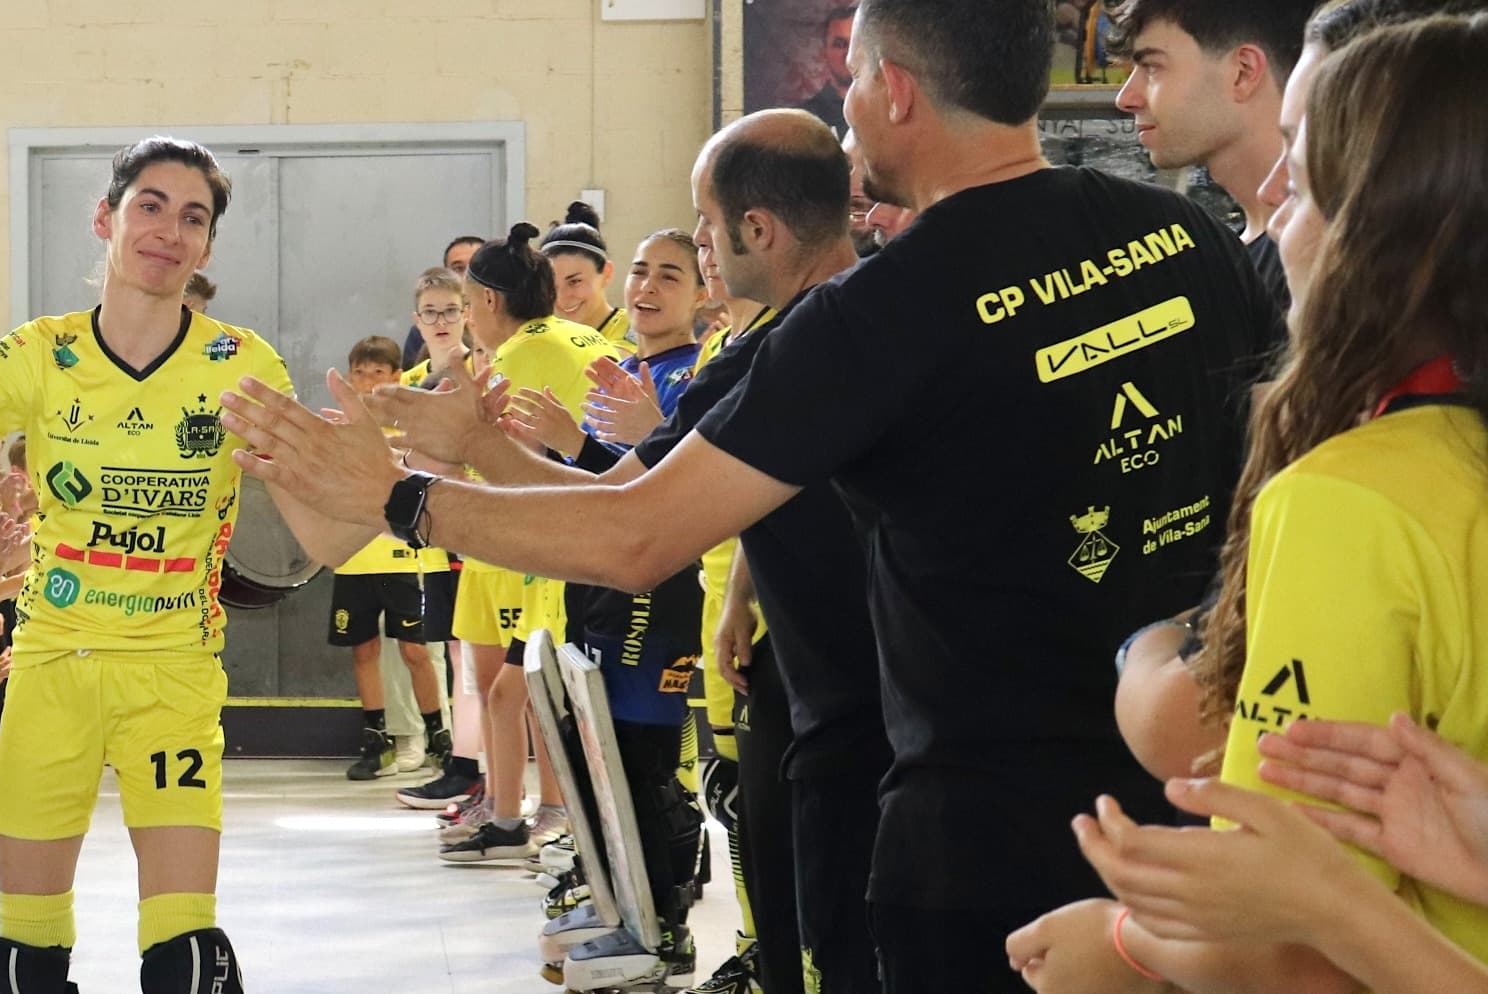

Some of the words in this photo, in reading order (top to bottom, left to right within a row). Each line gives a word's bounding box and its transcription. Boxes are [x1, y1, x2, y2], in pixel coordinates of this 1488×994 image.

[975, 285, 1025, 325] CP
[1029, 223, 1196, 305] VILA-SANA
[1047, 319, 1167, 373] VALL
[116, 421, 154, 430] ALTAN
[1094, 414, 1184, 465] ALTAN
[100, 474, 210, 488] COOPERATIVA
[1120, 450, 1160, 474] ECO
[101, 487, 208, 508] D'IVARS
[1143, 495, 1210, 535] Ajuntament
[86, 520, 166, 554] Pujol
[1142, 540, 1157, 555] de
[1159, 514, 1211, 548] Vila-Sana
[150, 748, 207, 790] 12
